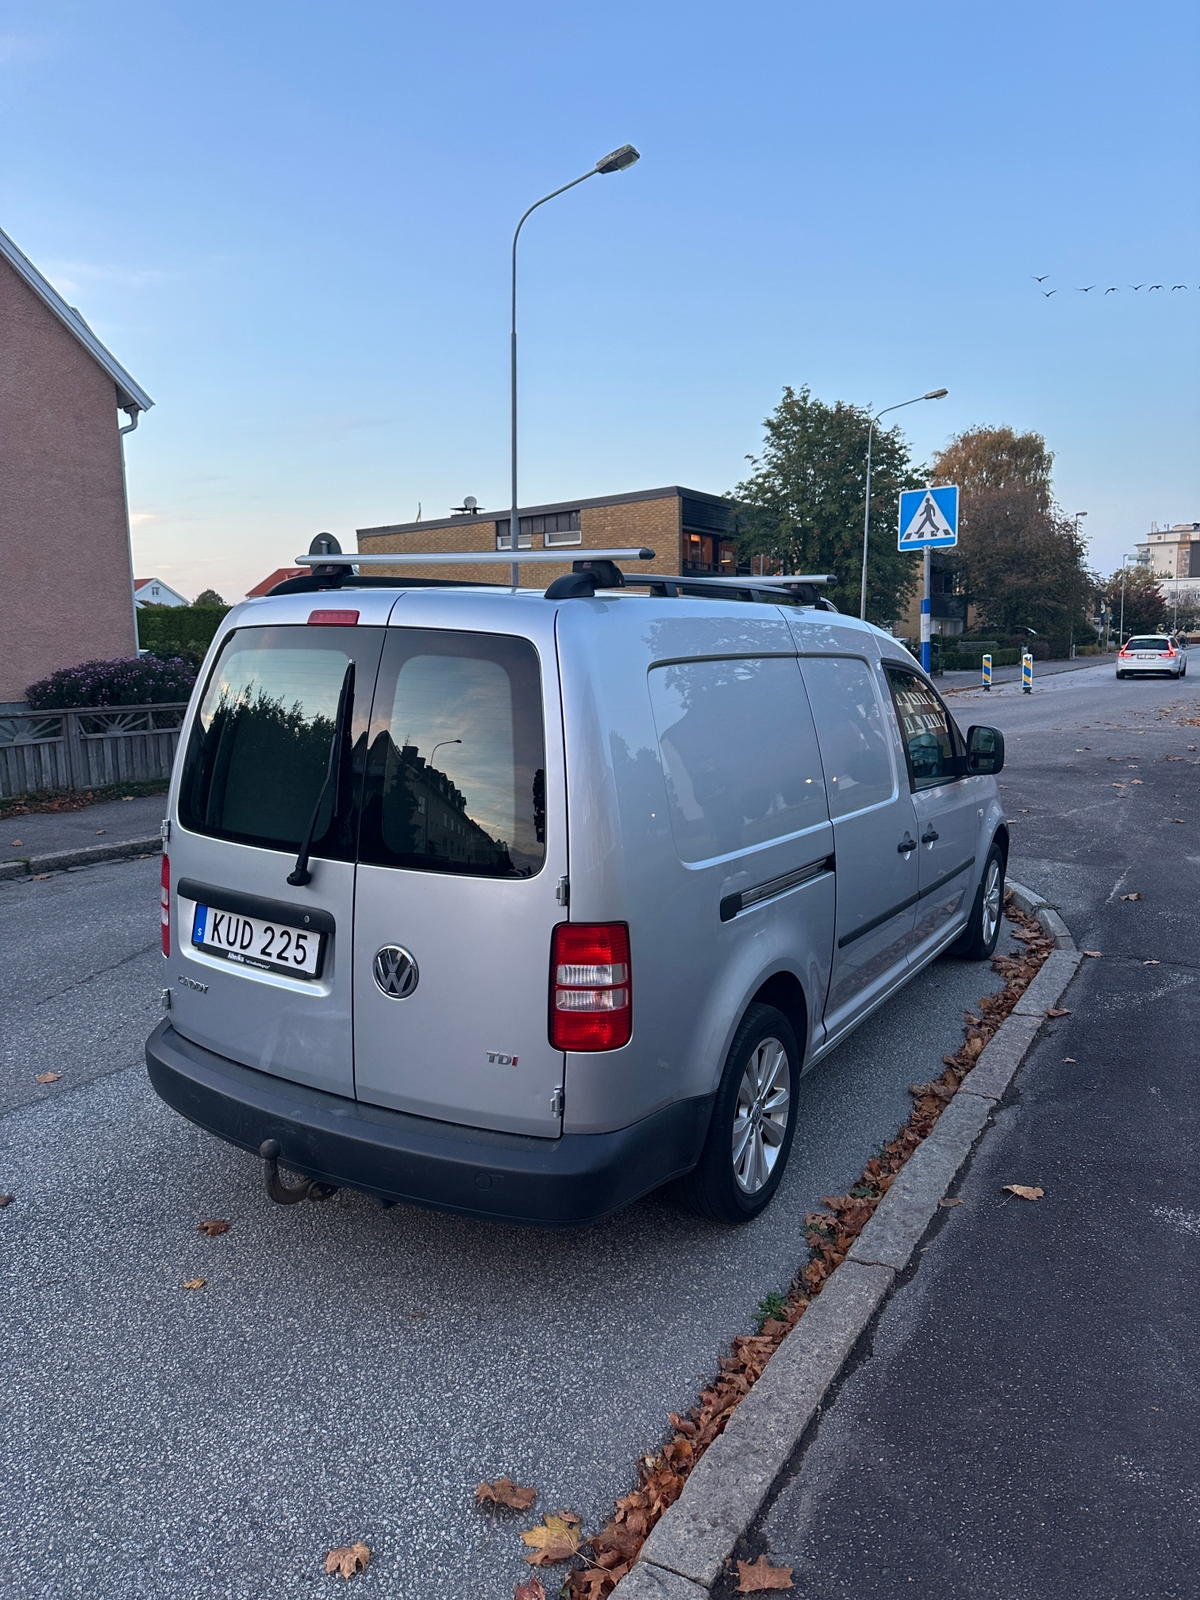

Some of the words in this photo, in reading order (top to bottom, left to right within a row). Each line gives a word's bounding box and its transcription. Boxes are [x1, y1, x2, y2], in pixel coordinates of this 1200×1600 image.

[197, 927, 203, 936] S
[210, 912, 253, 950] KUD
[260, 926, 308, 965] 225
[374, 946, 417, 997] VW
[178, 974, 209, 995] CADDY
[486, 1050, 519, 1067] TDI
